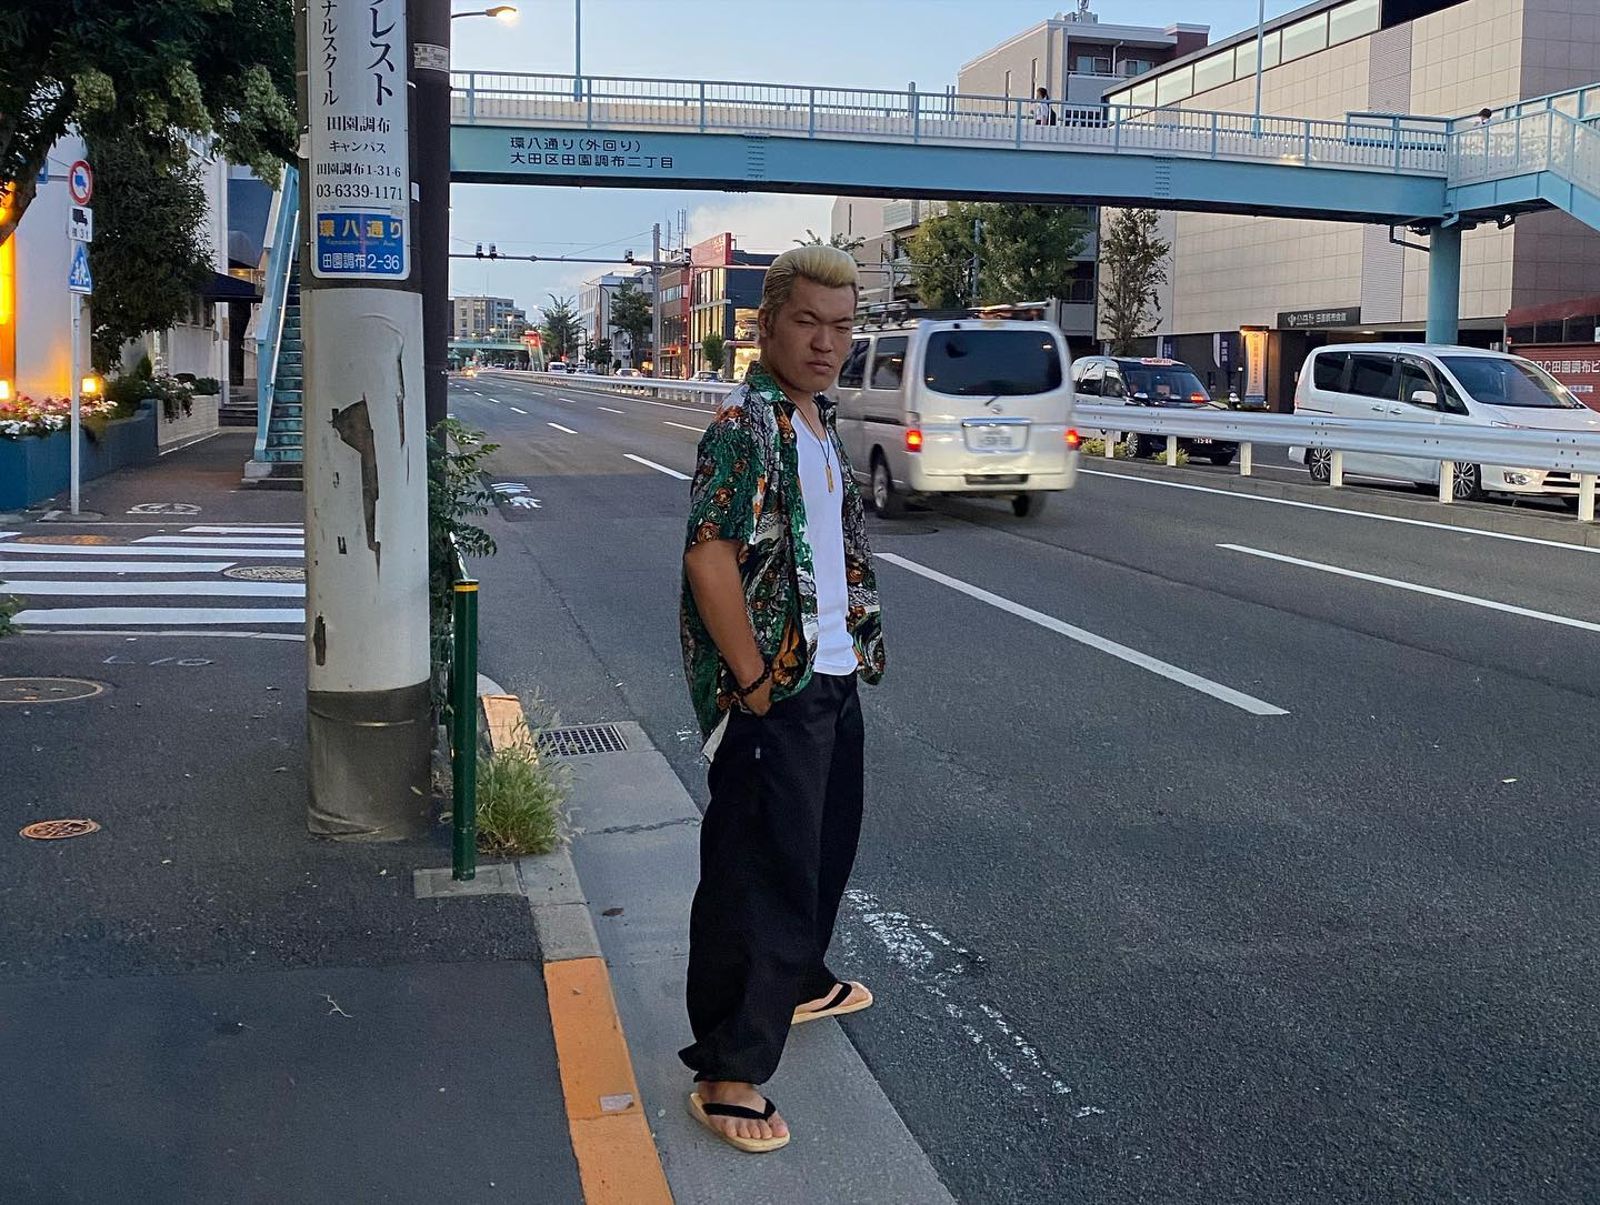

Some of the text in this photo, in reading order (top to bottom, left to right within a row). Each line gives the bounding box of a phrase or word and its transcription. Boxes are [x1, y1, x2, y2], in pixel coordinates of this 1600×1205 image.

[321, 0, 339, 105] ナルスクール
[366, 0, 396, 105] レスト
[327, 115, 391, 133] 田園調布
[329, 140, 387, 154] キャンパス
[510, 137, 641, 153] 環八通り(外回り)
[510, 152, 673, 169] 大田区田園調布二丁目
[316, 183, 402, 200] 03-6339-1171
[322, 252, 400, 270] 田園調布2-36
